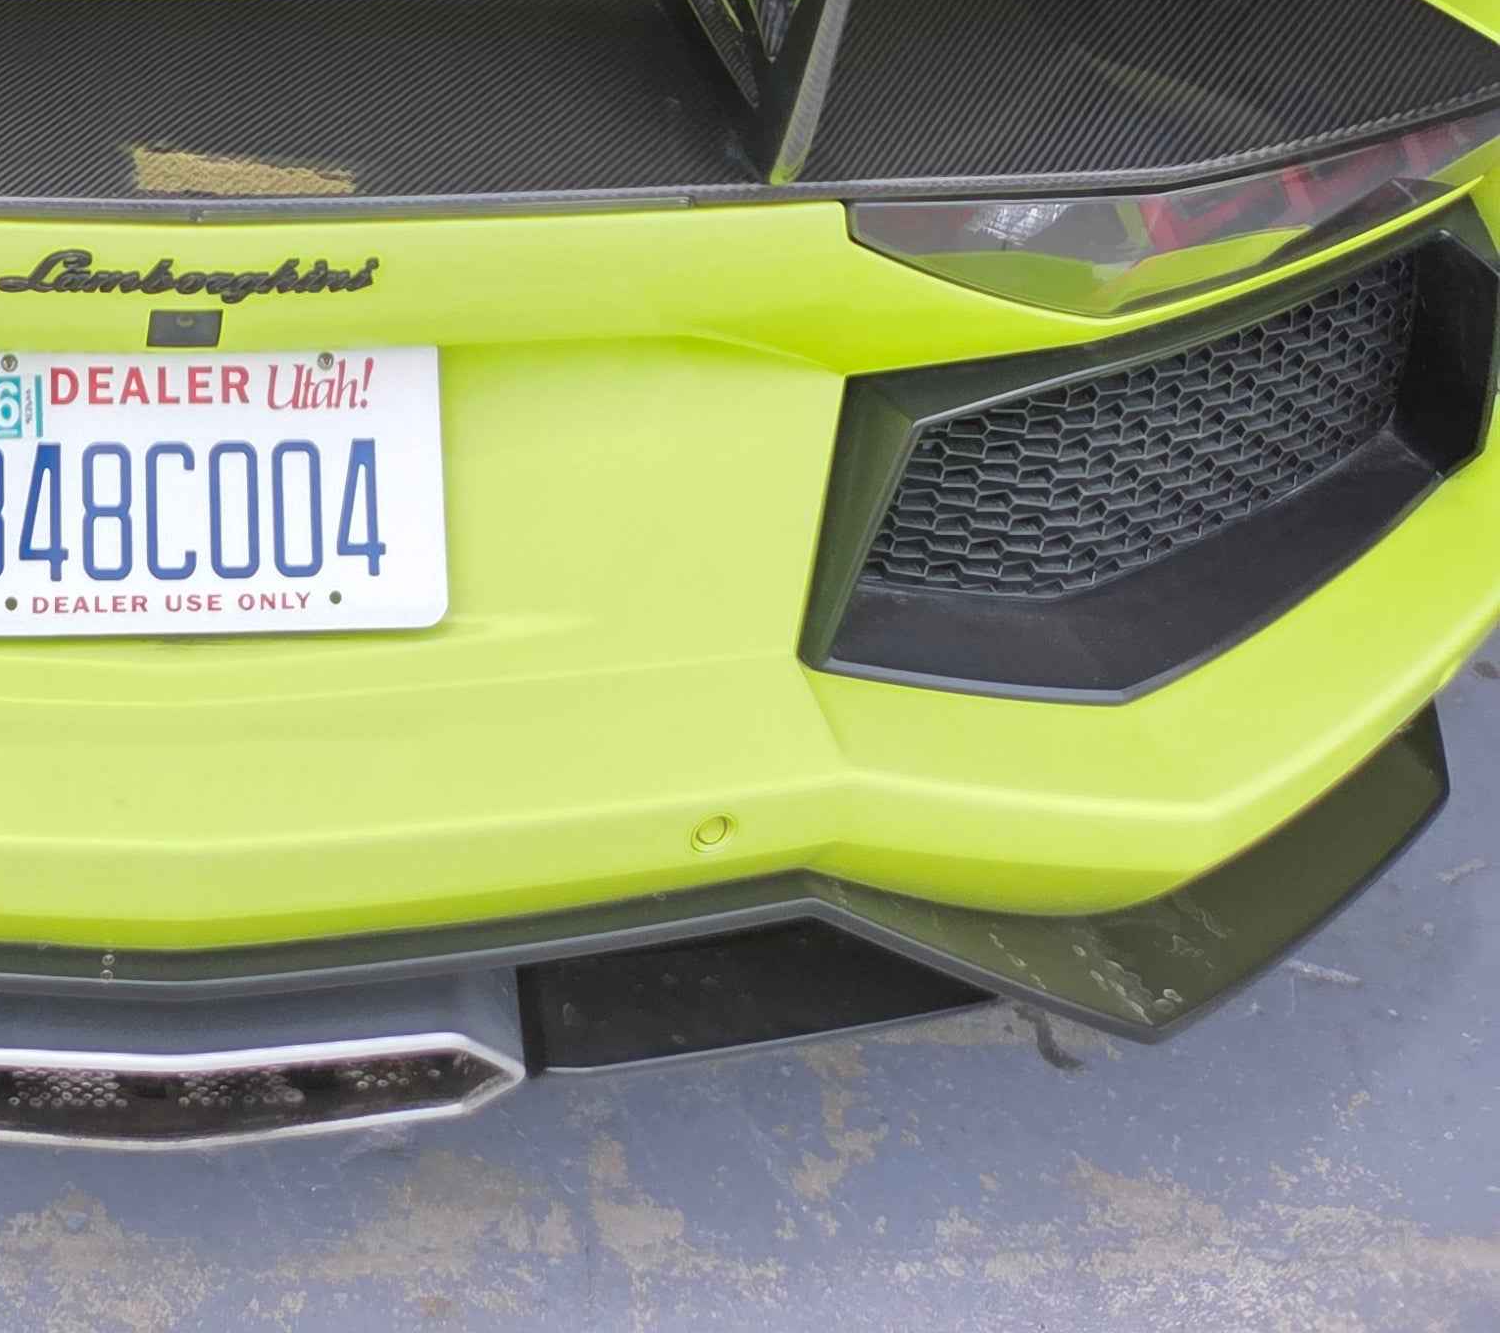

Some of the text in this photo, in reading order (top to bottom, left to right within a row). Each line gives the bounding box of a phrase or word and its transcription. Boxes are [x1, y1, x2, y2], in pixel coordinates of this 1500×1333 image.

[50, 357, 374, 411] DEALER Utah!
[32, 591, 311, 614] DEALER USE ONLY
